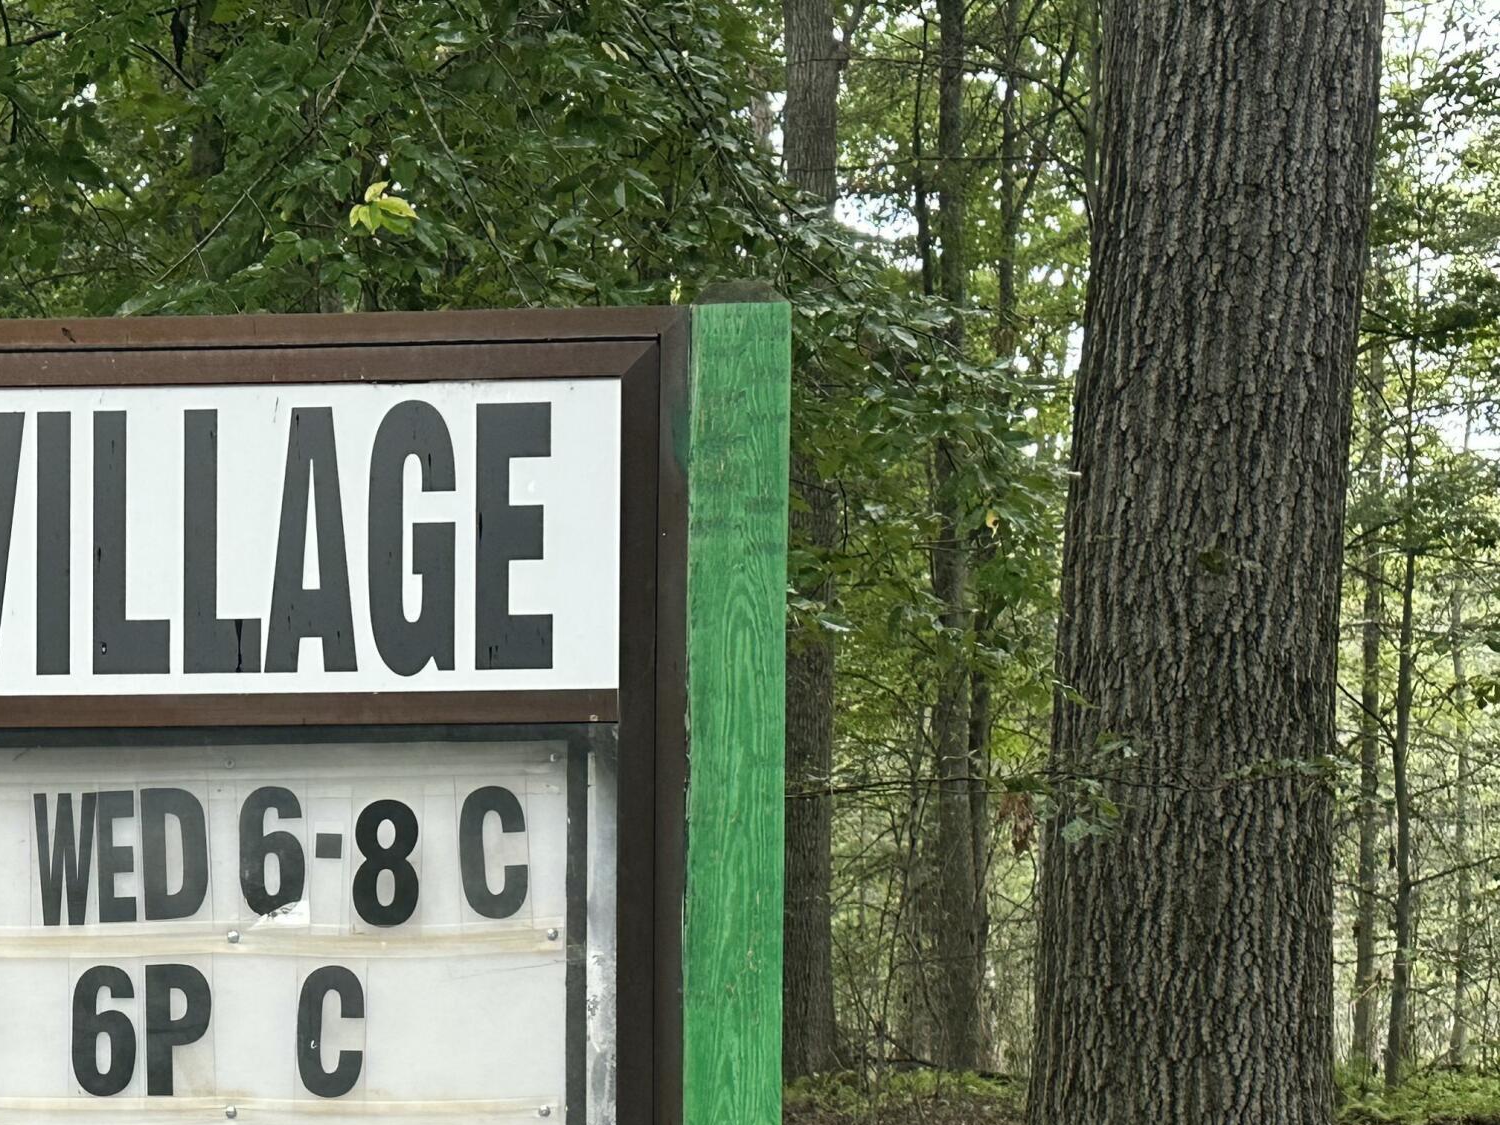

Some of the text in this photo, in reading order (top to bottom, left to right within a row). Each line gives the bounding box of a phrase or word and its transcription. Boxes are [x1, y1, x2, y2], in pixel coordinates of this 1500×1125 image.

[34, 788, 209, 926] WED
[238, 786, 419, 928] 6-8
[459, 785, 529, 920] C
[71, 963, 212, 1097] 6P
[297, 965, 365, 1098] C
